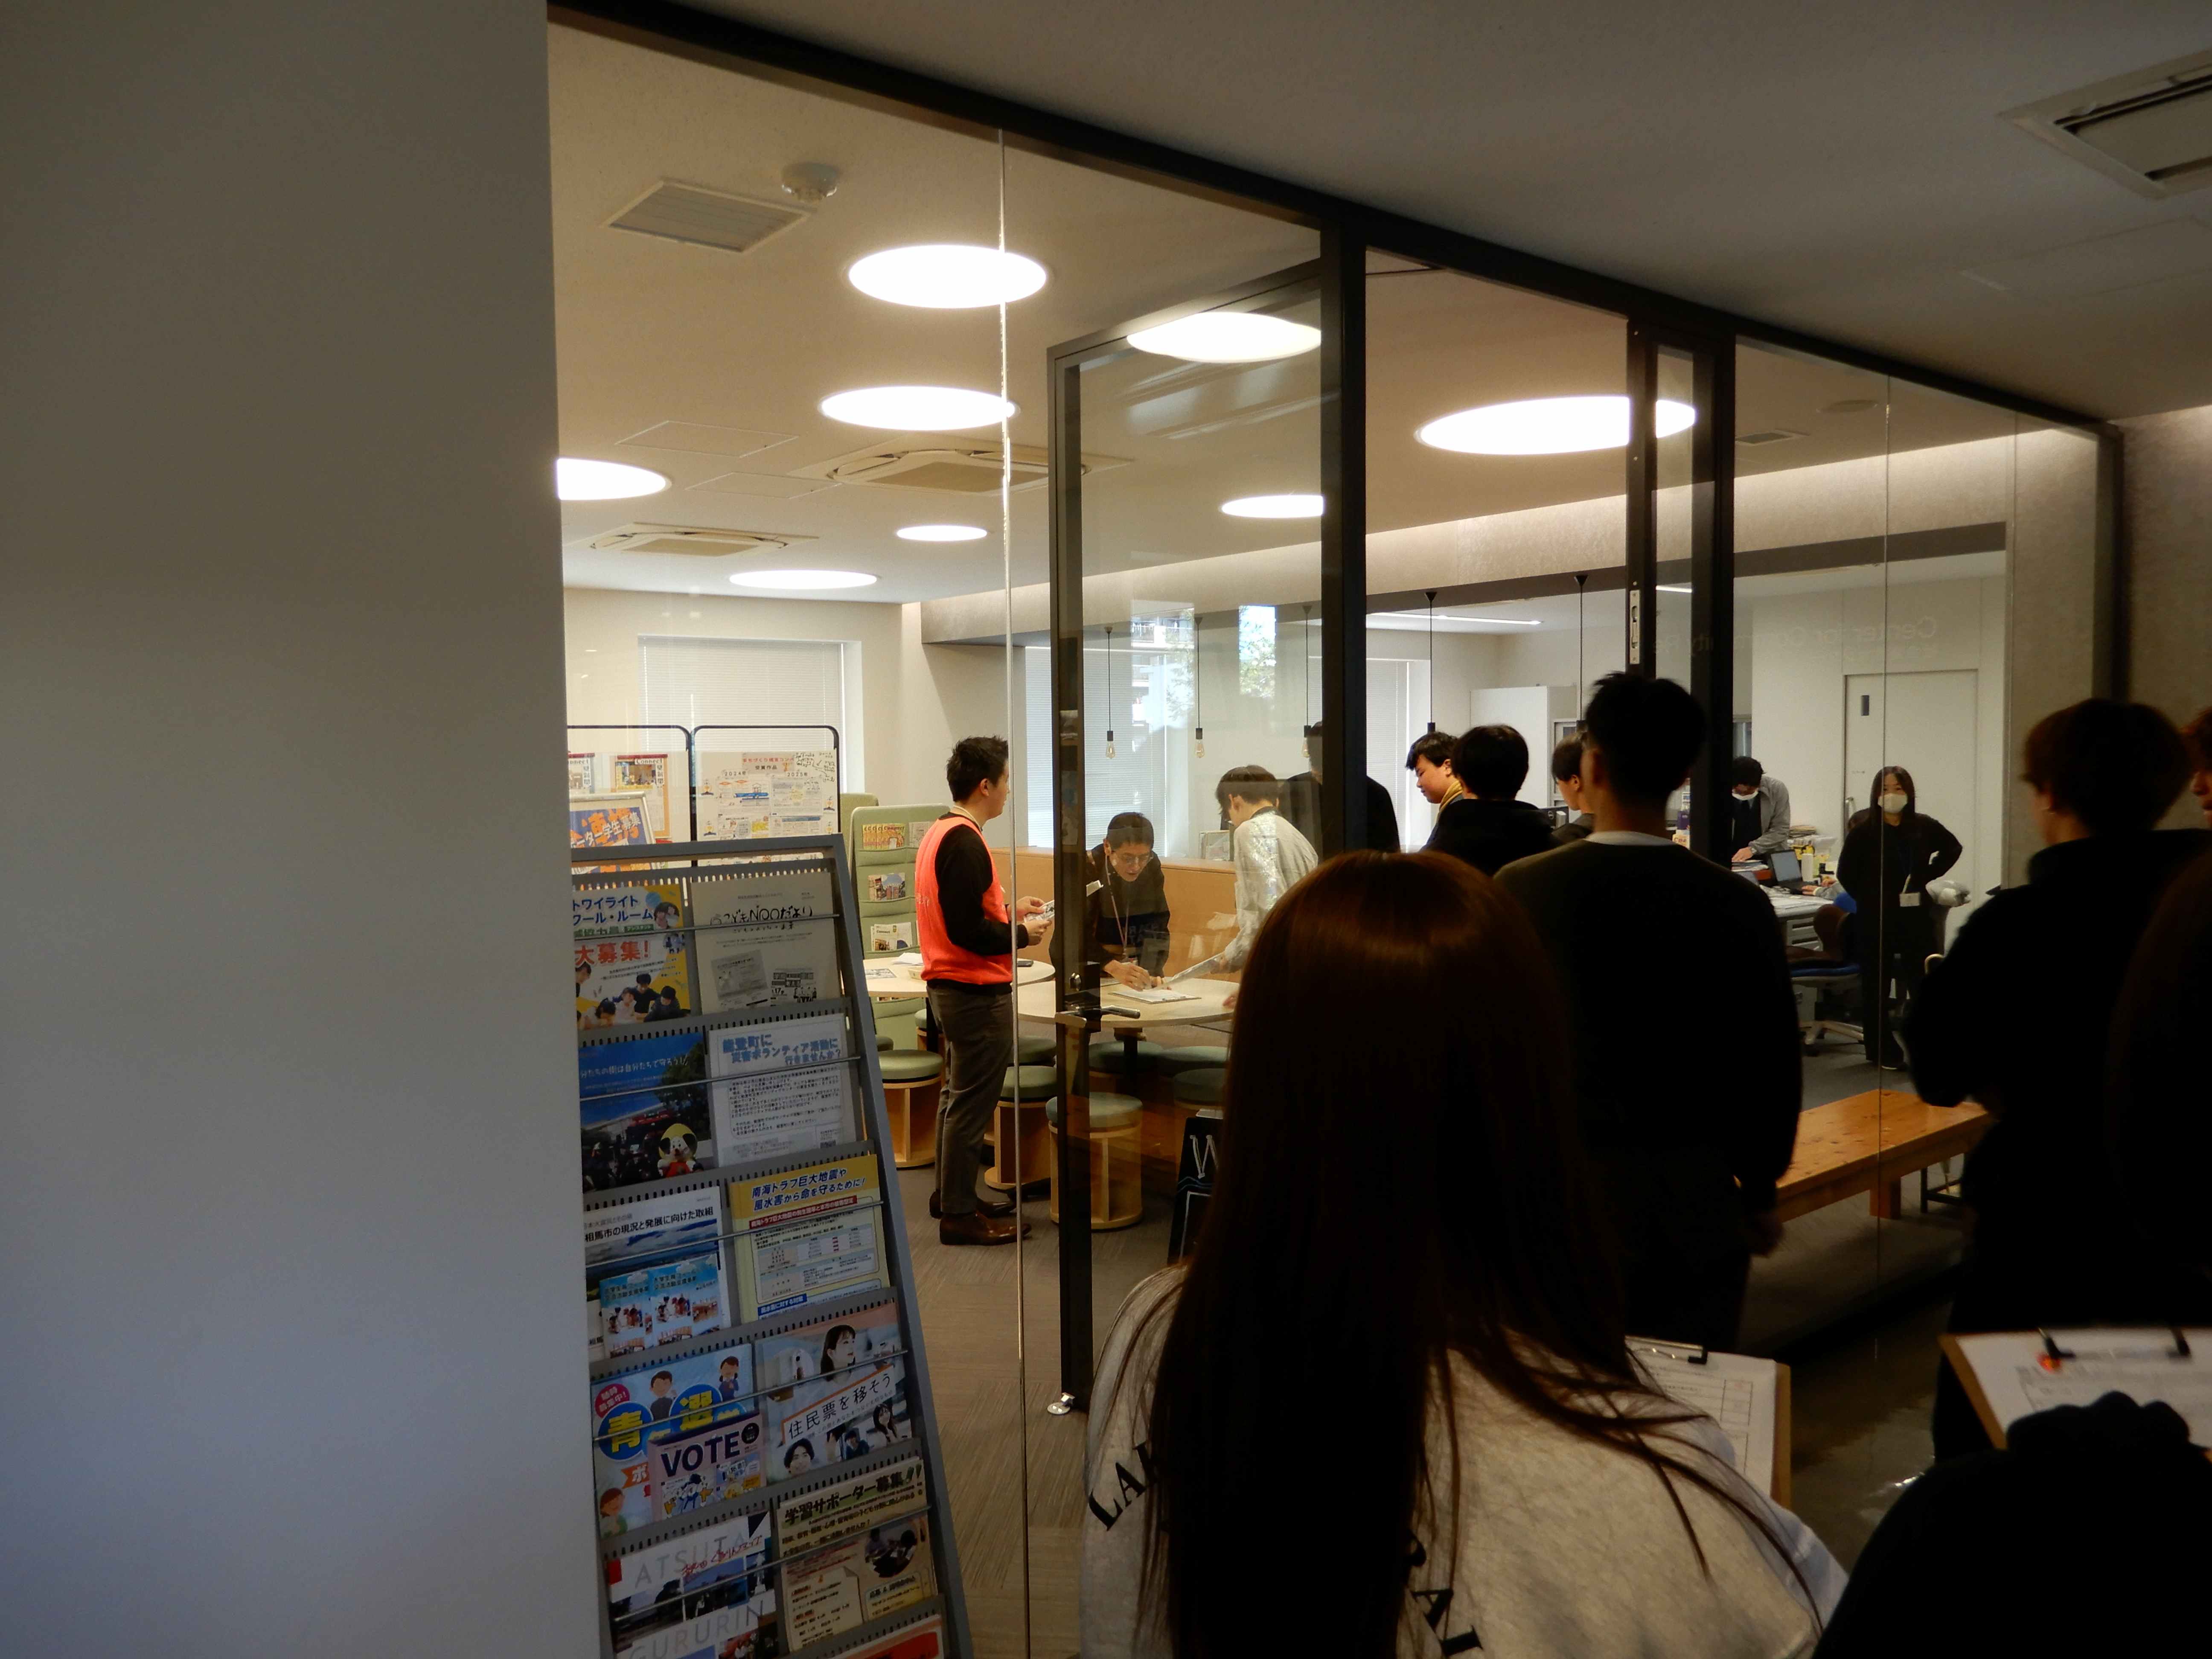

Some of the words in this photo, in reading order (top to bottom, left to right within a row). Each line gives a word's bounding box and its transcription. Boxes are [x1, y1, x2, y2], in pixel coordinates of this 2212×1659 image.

[573, 895, 638, 911] トワイライト
[751, 1168, 847, 1199] 南海トラフ巨大地震や
[585, 1206, 714, 1242] 相馬市の現況と発展に向けた取組
[789, 1373, 891, 1440] 住民票を移そう
[661, 1430, 741, 1478] VOTE
